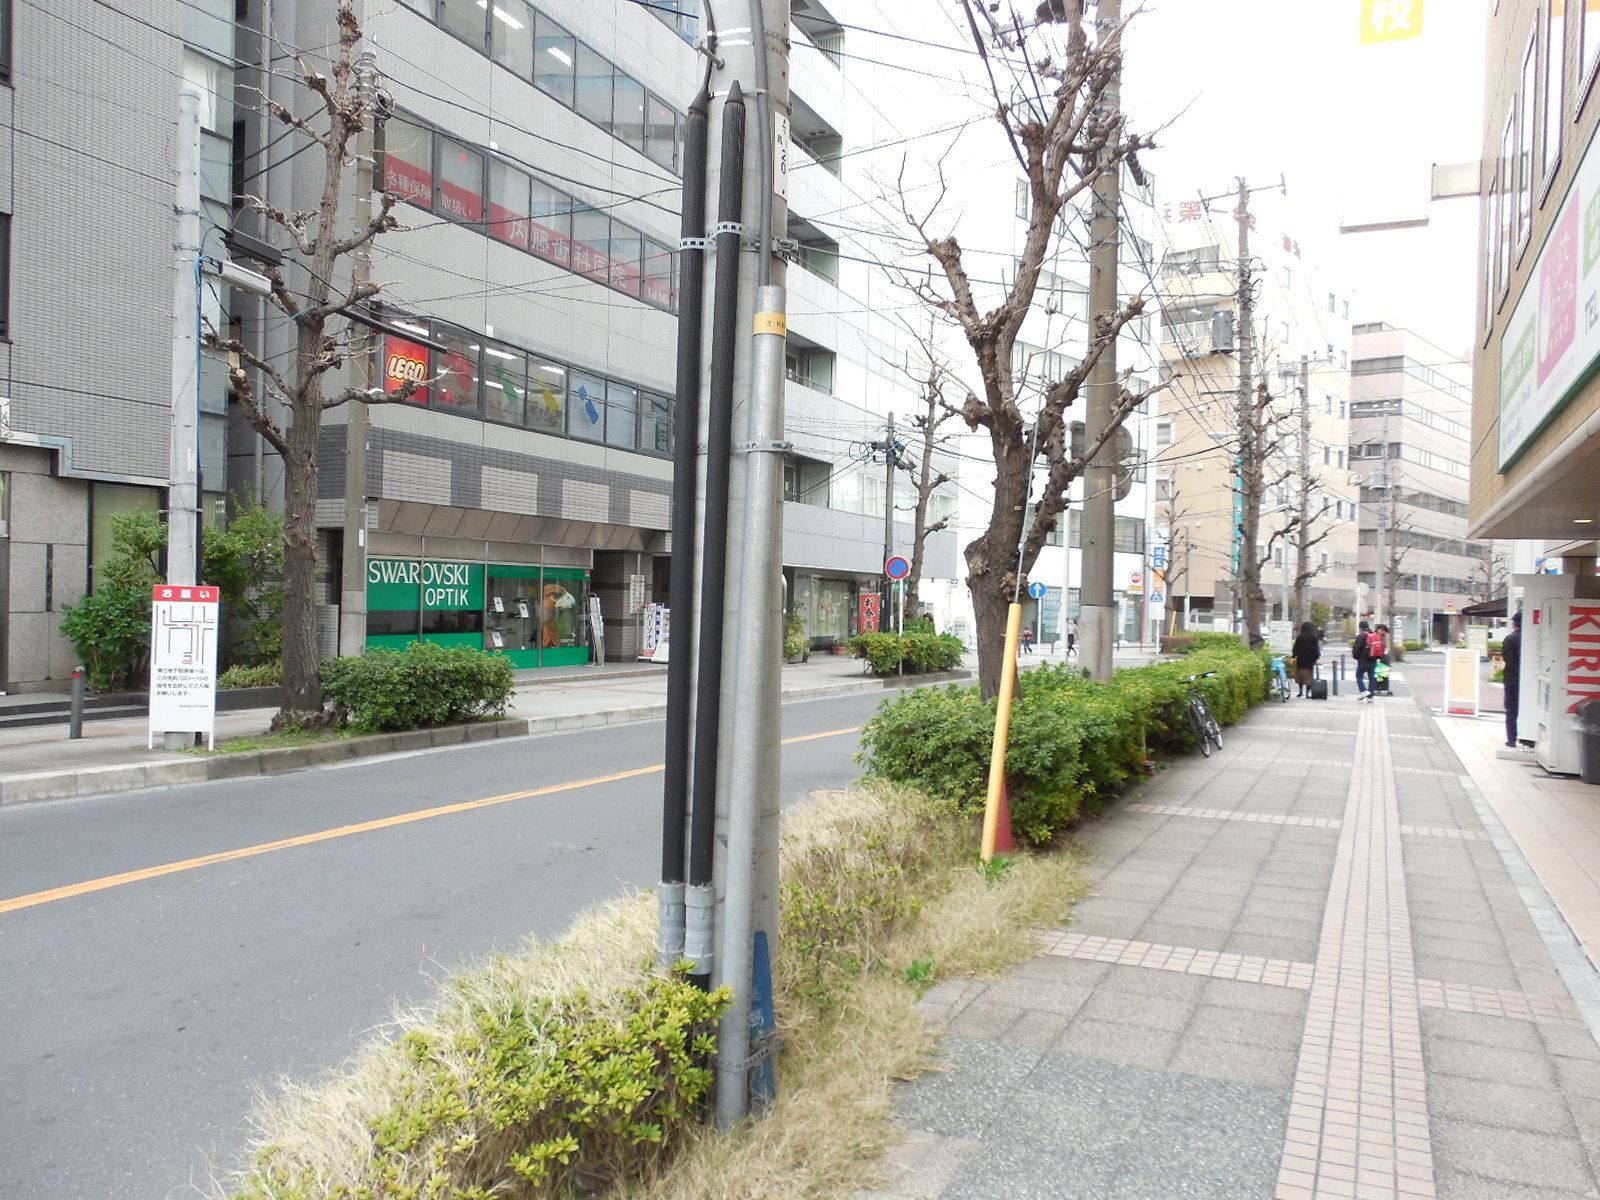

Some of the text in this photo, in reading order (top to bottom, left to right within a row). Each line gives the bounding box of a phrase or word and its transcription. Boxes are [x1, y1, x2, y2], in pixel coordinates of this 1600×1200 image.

[387, 169, 472, 218] 各種保険 取扱い
[509, 219, 626, 288] 内藤歯科医院
[387, 354, 426, 382] LEGO
[368, 560, 470, 586] SWAROVSKI
[161, 589, 210, 599] お願い
[425, 588, 470, 606] OPTIK
[1566, 605, 1600, 714] KIRIN
